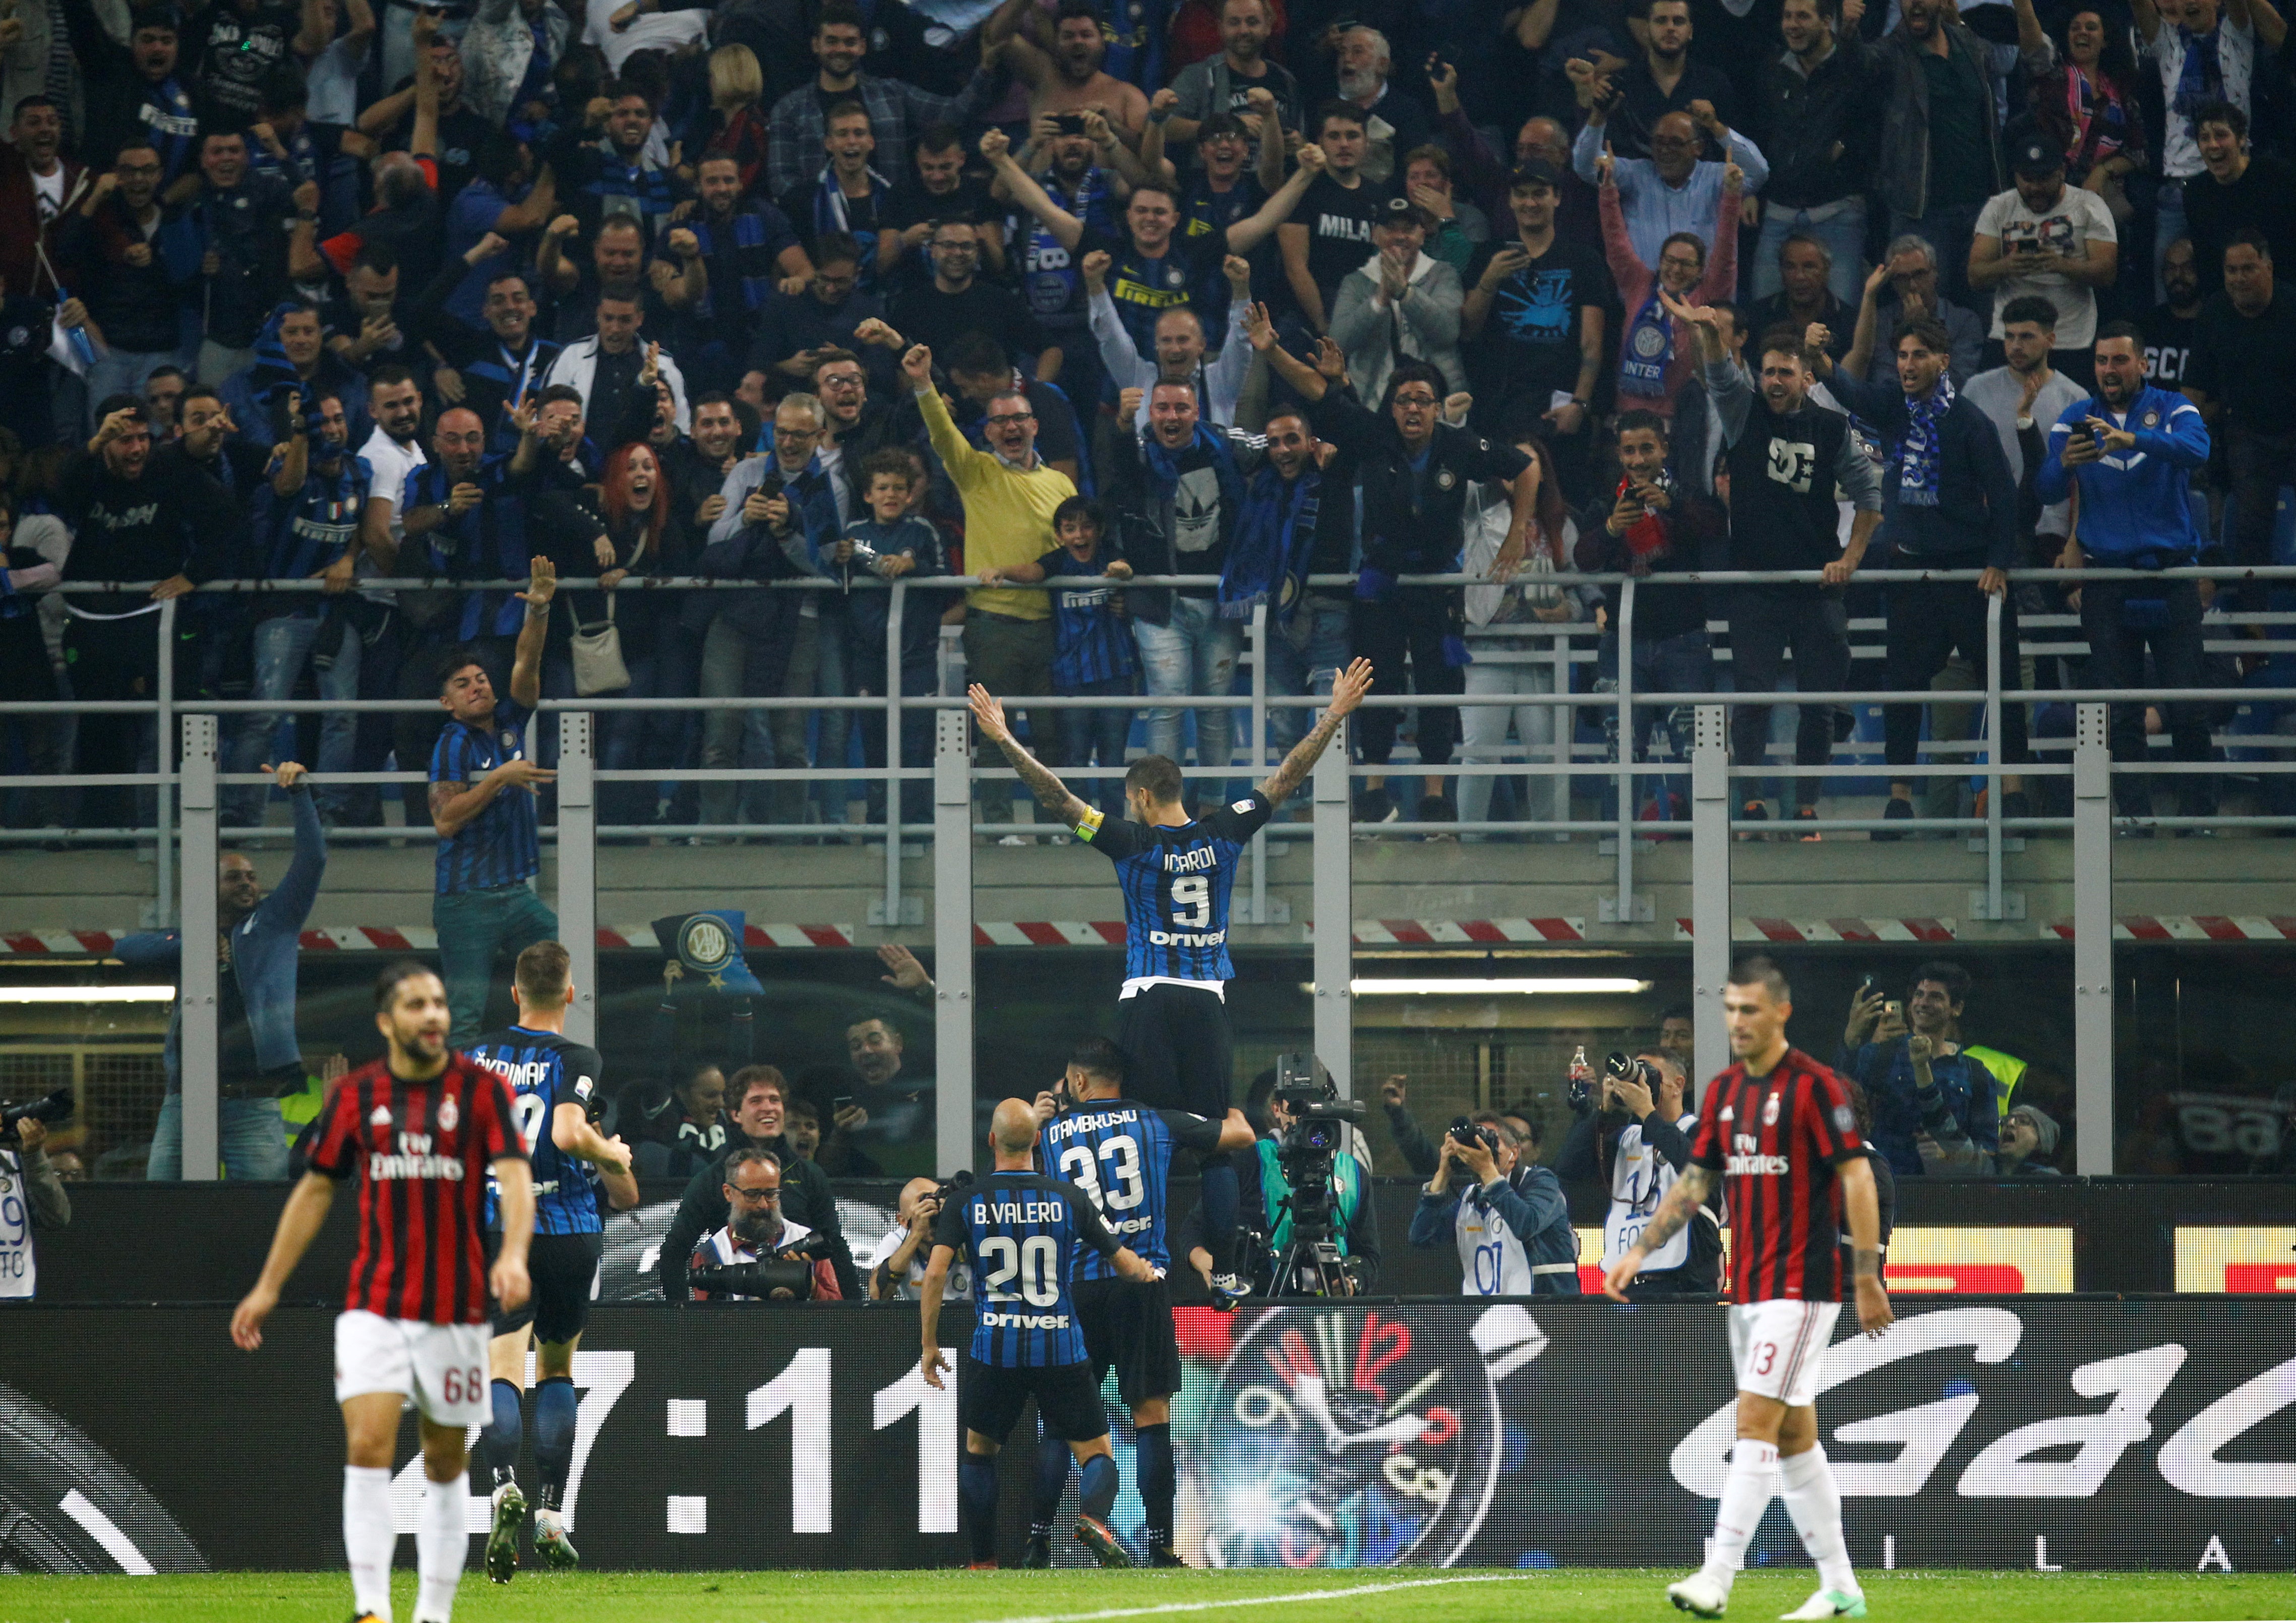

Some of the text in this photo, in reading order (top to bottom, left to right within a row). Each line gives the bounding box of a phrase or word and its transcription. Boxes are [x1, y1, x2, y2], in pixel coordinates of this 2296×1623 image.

[1623, 359, 1661, 379] INTER
[1164, 846, 1217, 873] ICARDI
[1171, 875, 1210, 928] 9
[1060, 1134, 1144, 1212] 33
[0, 1196, 26, 1246] 9
[1619, 1225, 1668, 1254] FO
[979, 1236, 1059, 1307] 20
[1475, 1241, 1502, 1295] 01
[983, 1311, 1069, 1330] Driver.
[1750, 1342, 1778, 1376] 13
[444, 1366, 483, 1405] 68
